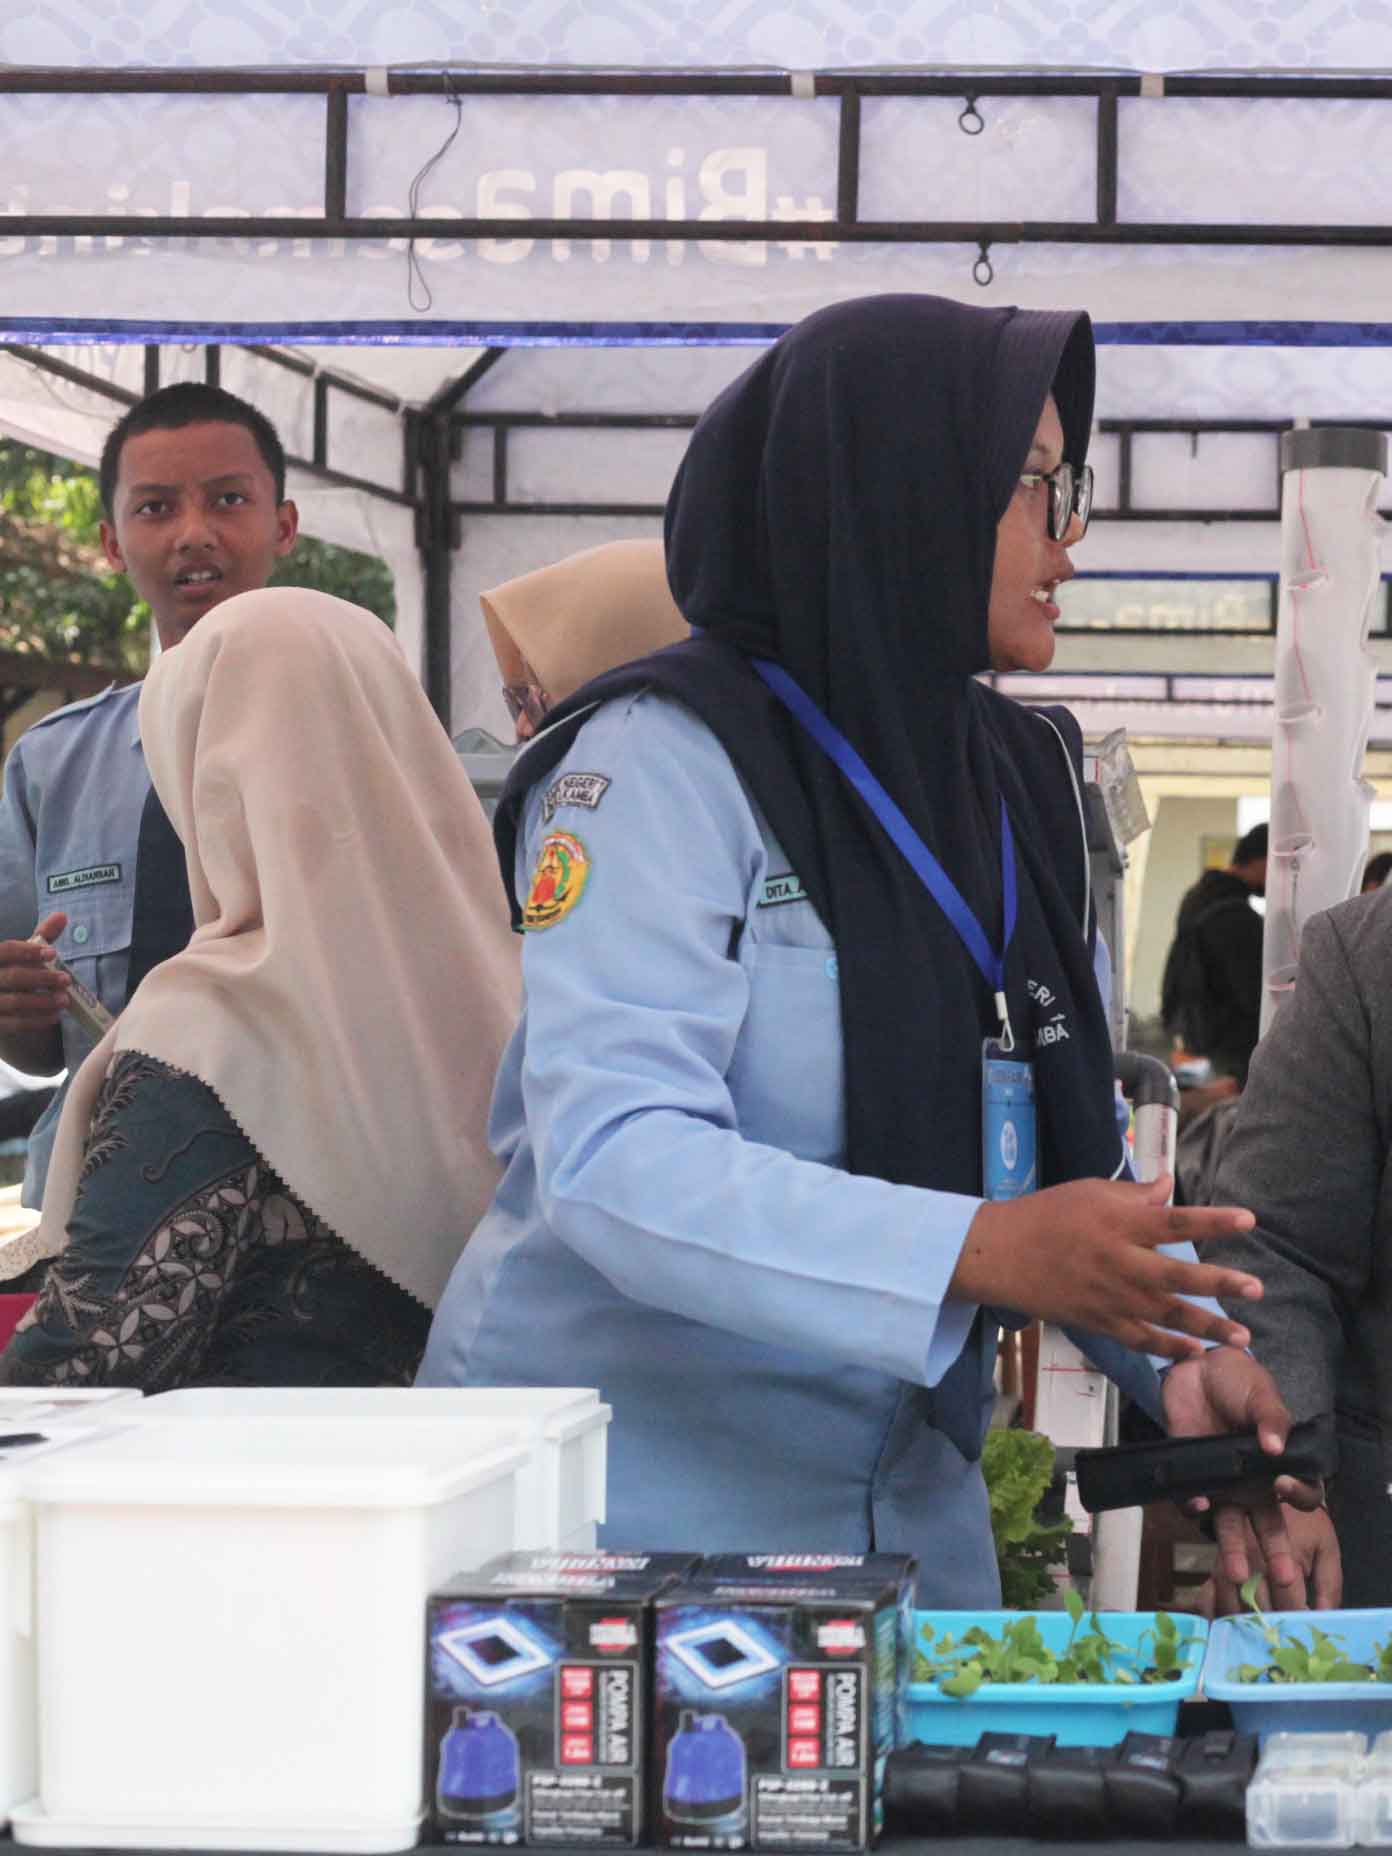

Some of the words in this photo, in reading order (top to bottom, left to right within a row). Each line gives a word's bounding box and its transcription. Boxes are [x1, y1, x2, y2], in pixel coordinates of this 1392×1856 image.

[766, 881, 791, 898] DITA
[608, 1669, 629, 1732] POMPA
[835, 1672, 857, 1735] POMPA
[608, 1732, 629, 1764] AIR
[835, 1735, 857, 1767] AIR
